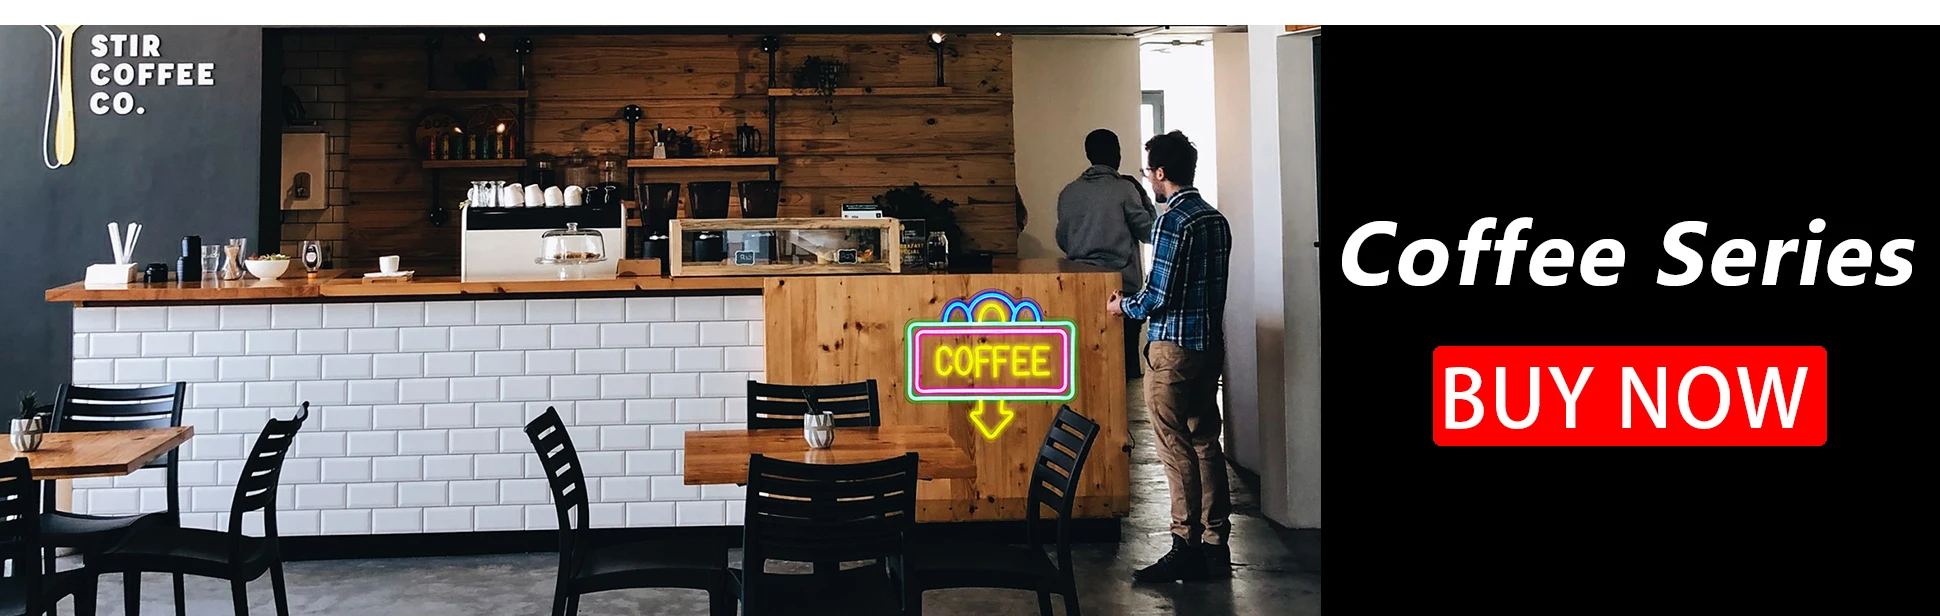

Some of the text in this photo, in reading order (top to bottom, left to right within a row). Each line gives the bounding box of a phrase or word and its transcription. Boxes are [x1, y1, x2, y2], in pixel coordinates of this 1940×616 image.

[90, 34, 161, 58] STIR
[90, 62, 215, 86] COFFEE
[89, 91, 146, 115] CO.
[934, 344, 1052, 379] COFFEE
